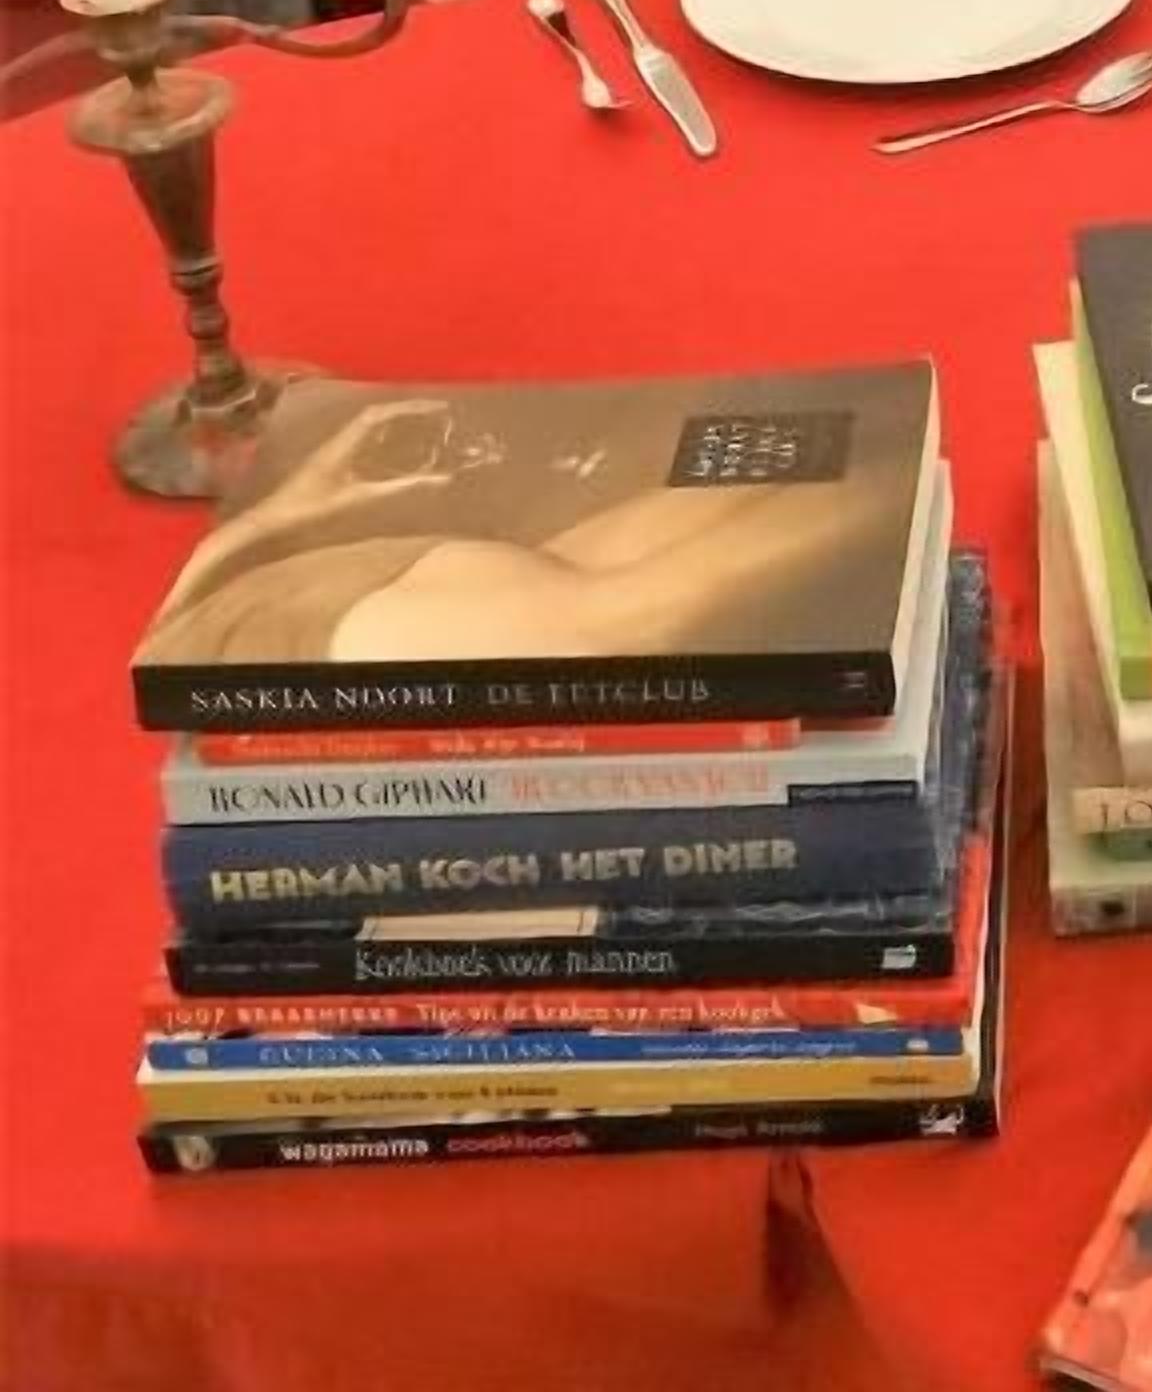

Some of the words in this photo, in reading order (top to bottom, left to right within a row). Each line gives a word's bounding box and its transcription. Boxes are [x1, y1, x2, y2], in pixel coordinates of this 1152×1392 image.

[189, 684, 319, 711] SASKIA
[488, 683, 535, 706] DE
[208, 781, 346, 814] RONALD
[209, 860, 405, 904] HERMAN
[418, 853, 542, 891] KOCH
[559, 846, 646, 882] HET
[662, 837, 798, 875] DINER
[278, 1136, 430, 1167] wagamama
